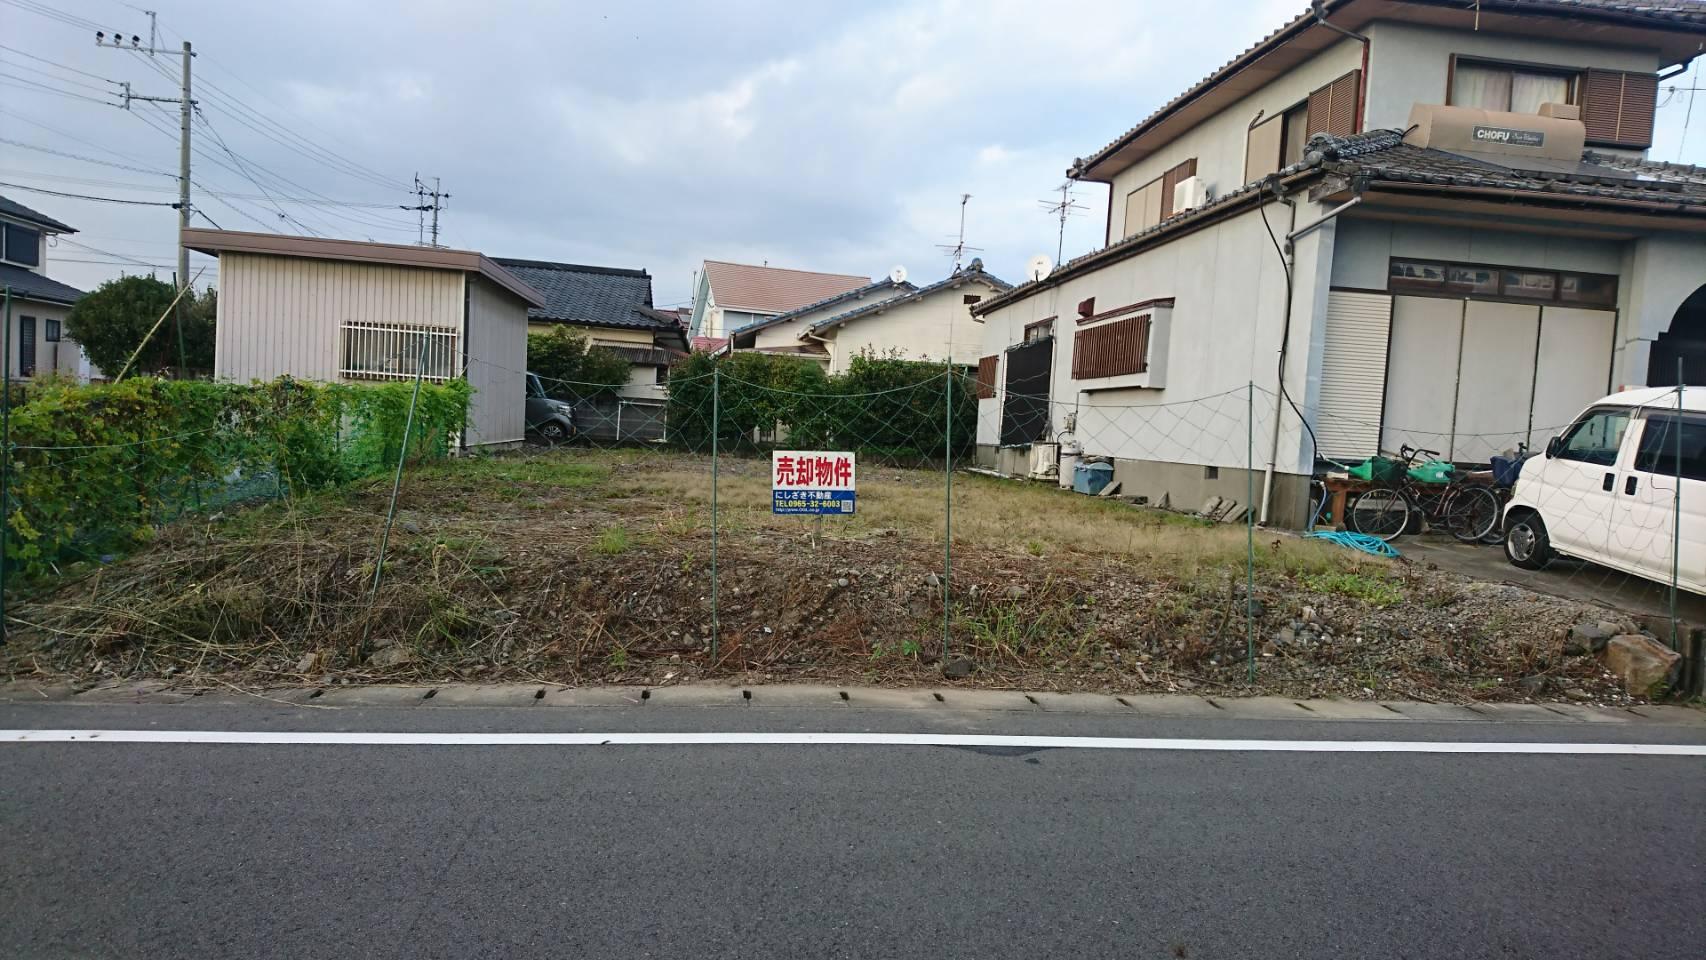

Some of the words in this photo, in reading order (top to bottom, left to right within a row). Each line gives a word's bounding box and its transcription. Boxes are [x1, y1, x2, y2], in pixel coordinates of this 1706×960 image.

[1477, 129, 1510, 141] CHOFU
[776, 456, 852, 486] 売却物件
[775, 491, 832, 500] にしざき不動産
